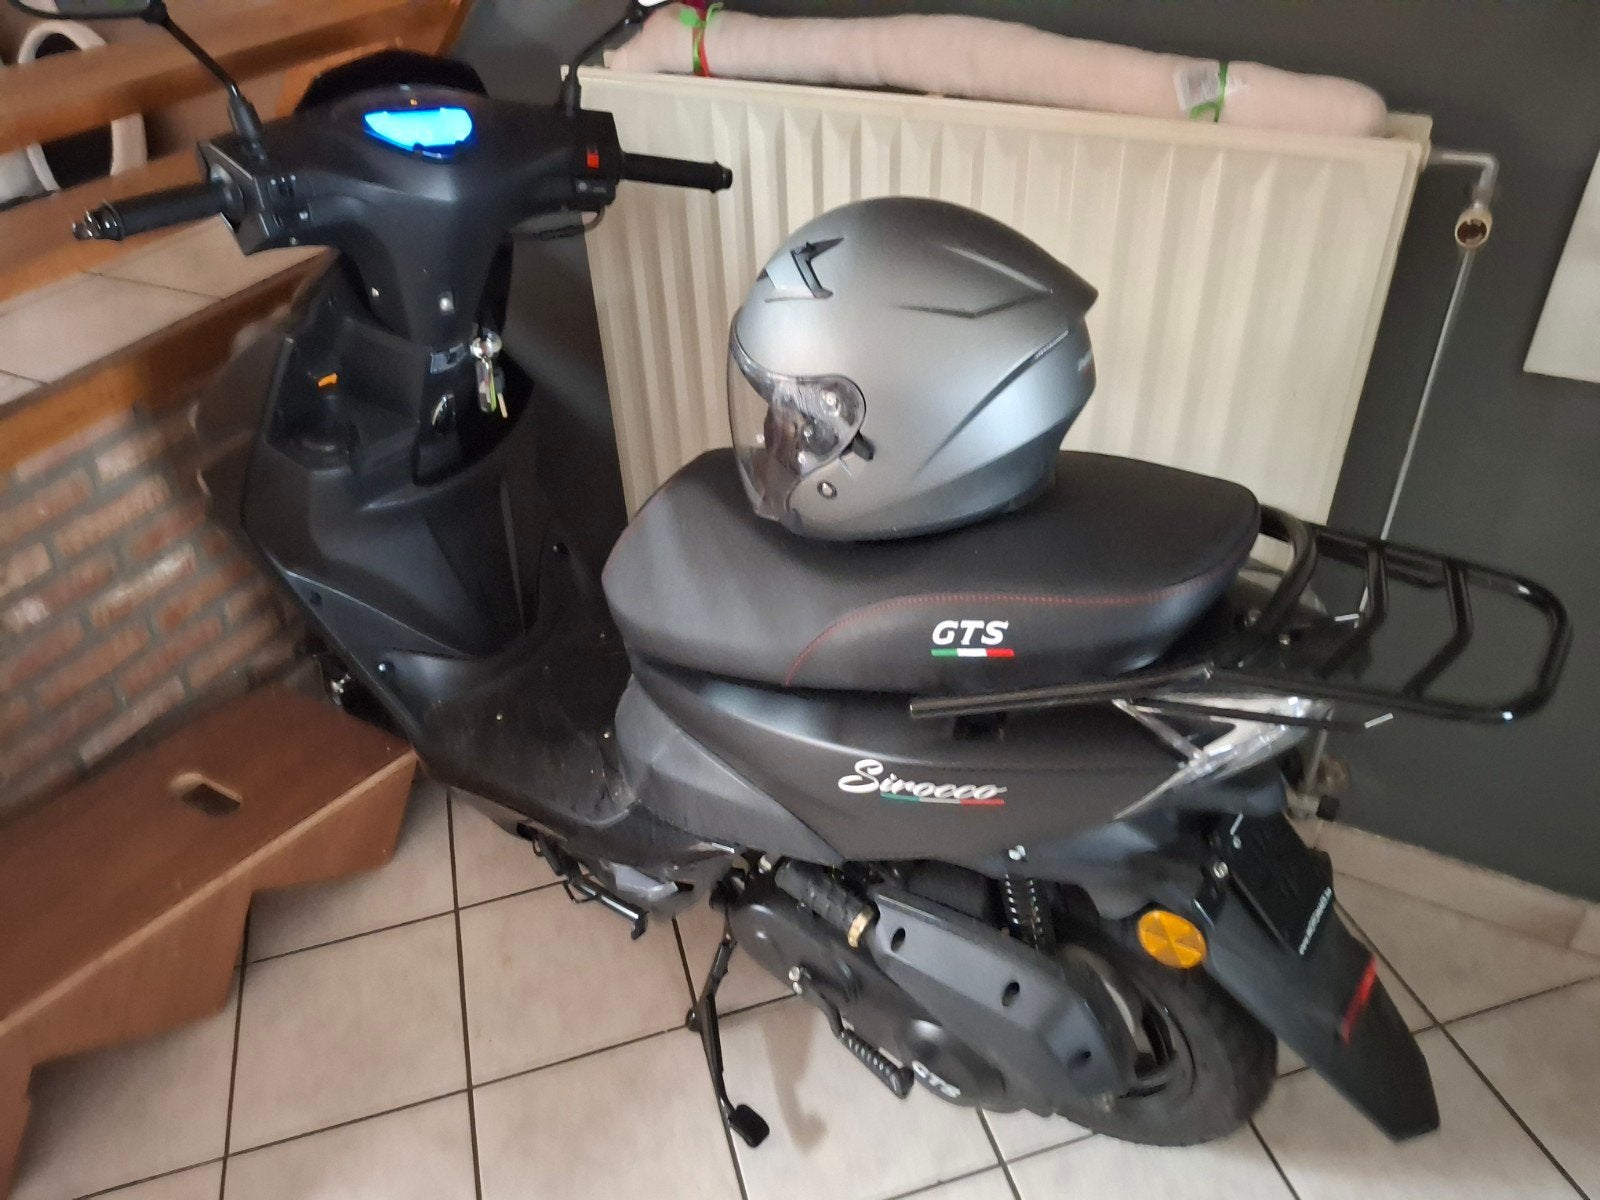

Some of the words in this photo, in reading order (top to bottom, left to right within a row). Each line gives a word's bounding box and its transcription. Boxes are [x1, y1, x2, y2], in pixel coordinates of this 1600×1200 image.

[932, 619, 1009, 646] GTS
[838, 759, 1007, 800] Sirocco
[912, 1060, 961, 1098] GTS
